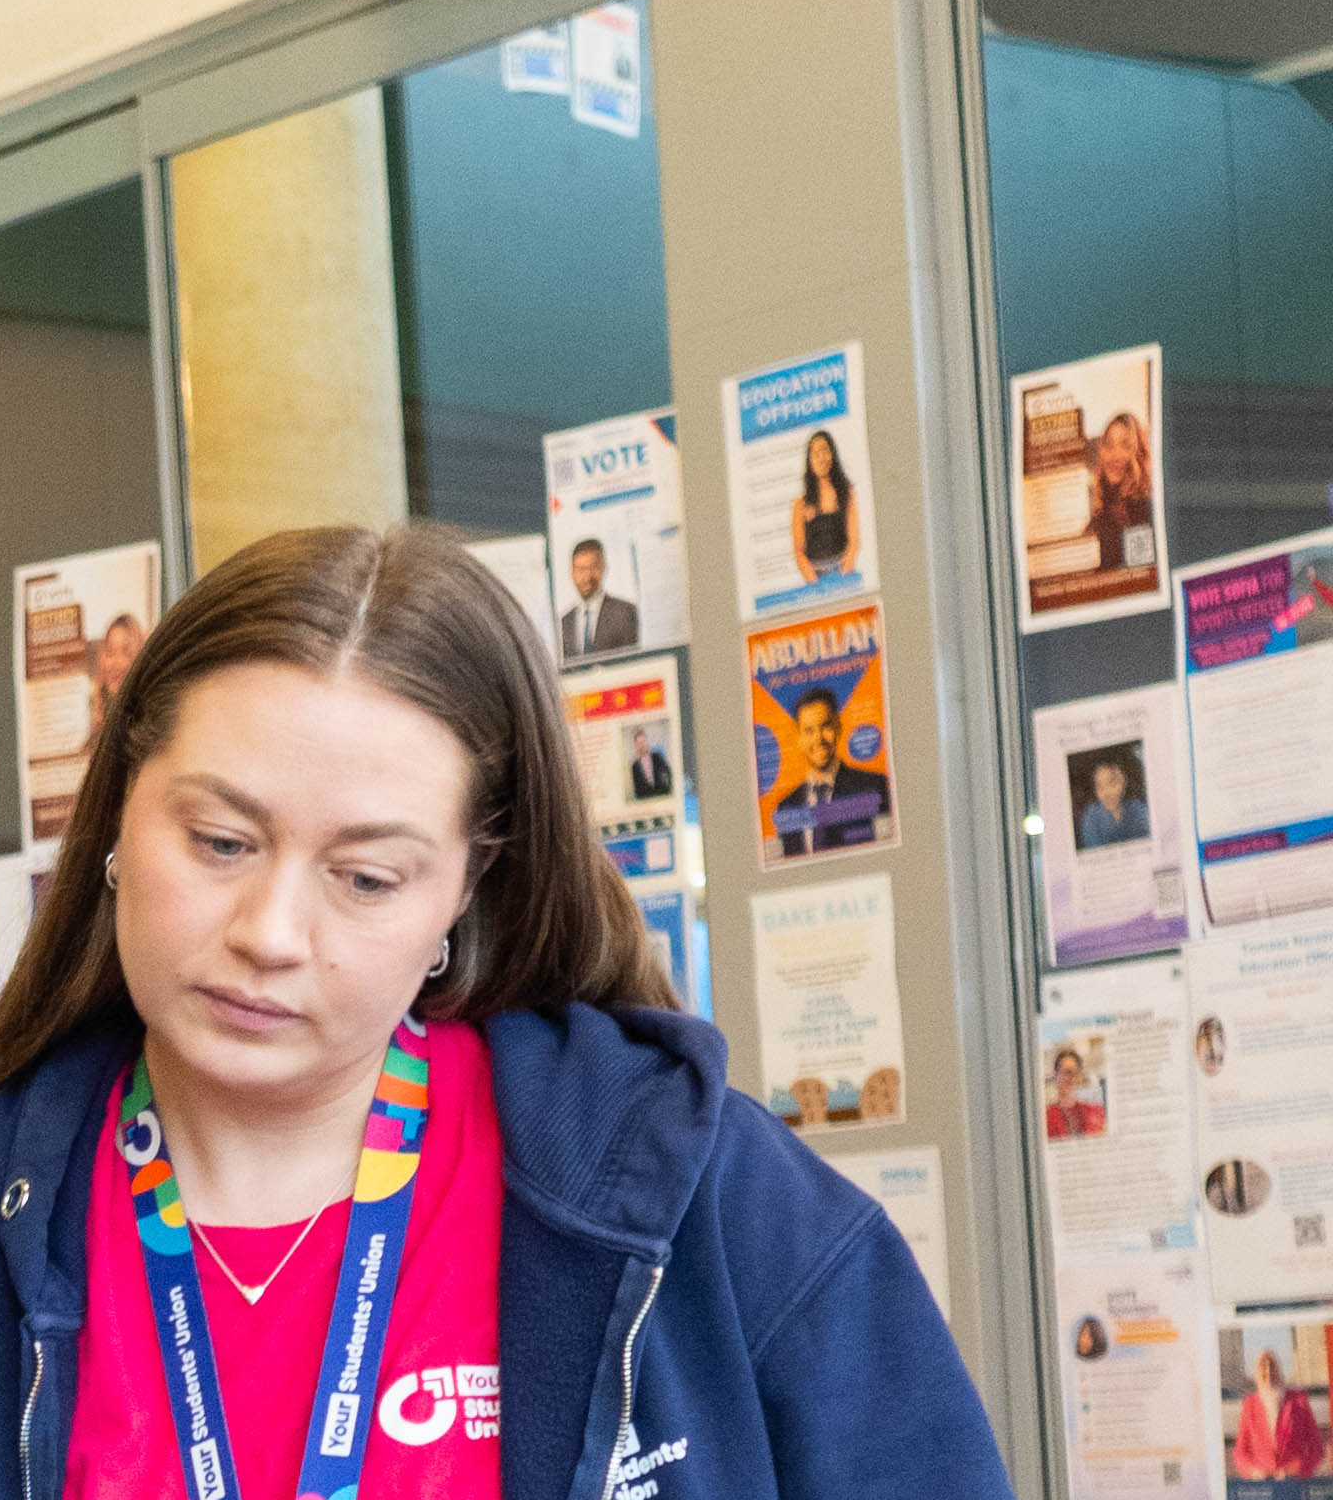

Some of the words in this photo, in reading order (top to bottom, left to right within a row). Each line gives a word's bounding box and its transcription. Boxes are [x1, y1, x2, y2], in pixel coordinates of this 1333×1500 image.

[741, 367, 845, 410] EDUCATION
[756, 390, 838, 427] OFFICER
[581, 442, 650, 475] VOTE
[169, 1285, 191, 1347] Union
[328, 1400, 352, 1448] Your
[358, 1233, 386, 1294] Union
[463, 1373, 500, 1388] You
[200, 1449, 218, 1499] Your
